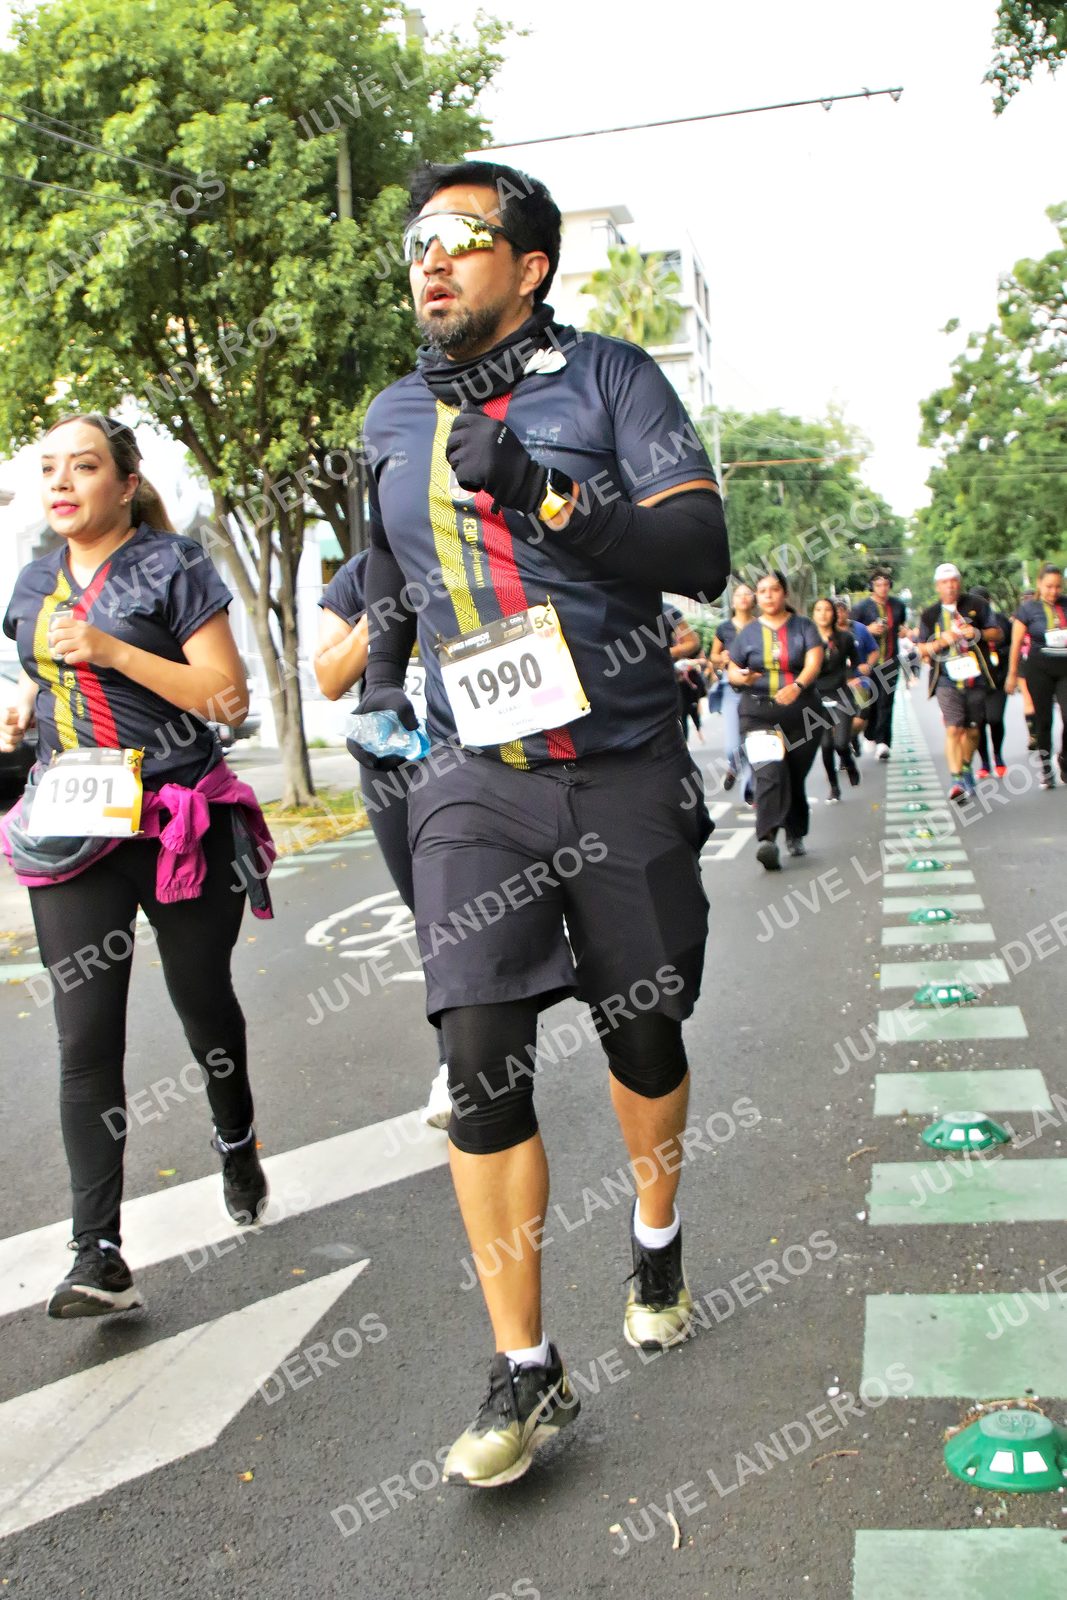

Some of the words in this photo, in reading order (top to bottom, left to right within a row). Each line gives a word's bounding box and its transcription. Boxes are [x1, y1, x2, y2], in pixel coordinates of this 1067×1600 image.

[534, 613, 552, 629] 5K
[458, 652, 542, 709] 1990
[51, 777, 114, 804] 1991
